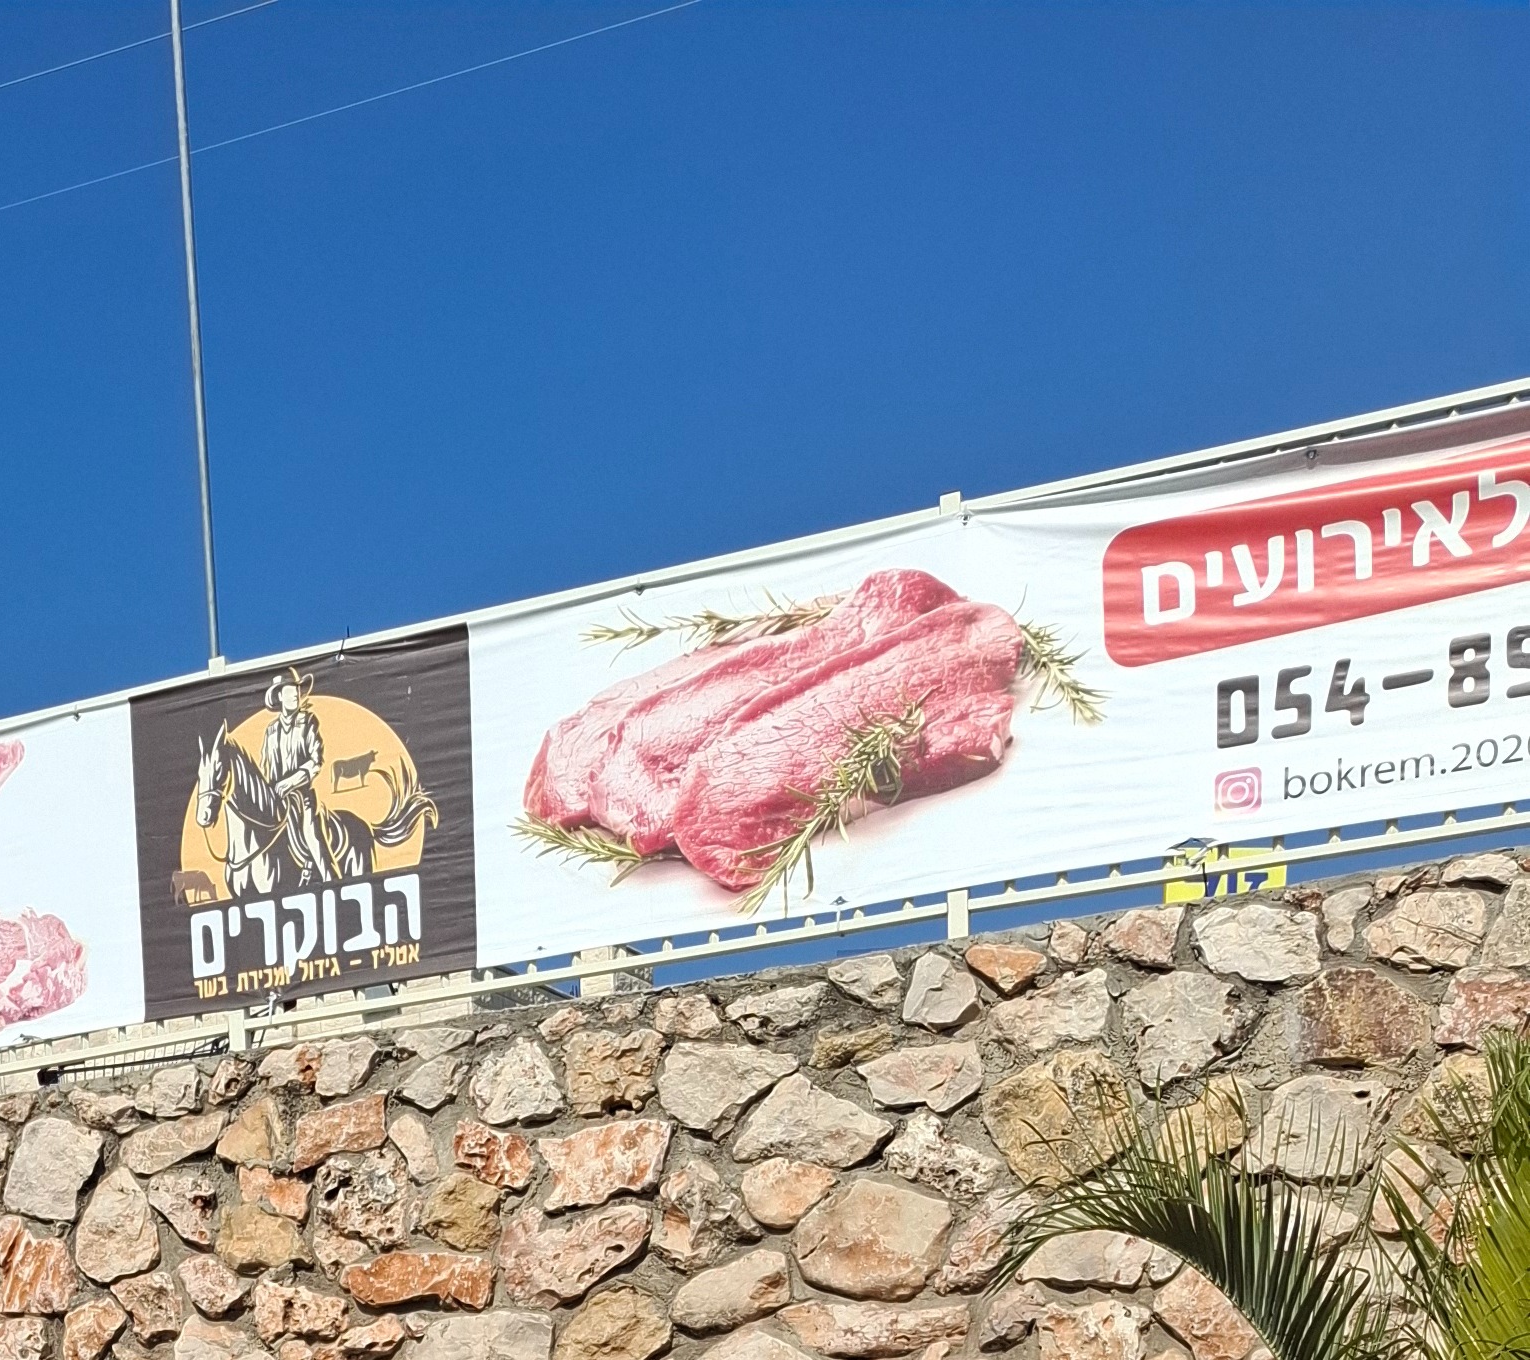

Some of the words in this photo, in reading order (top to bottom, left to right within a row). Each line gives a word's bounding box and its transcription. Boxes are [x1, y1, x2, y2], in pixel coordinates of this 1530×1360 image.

[1141, 470, 1530, 626] לאירועים
[1216, 625, 1530, 749] 054-89
[1284, 734, 1530, 800] bokrem.202
[191, 873, 421, 978] הבוקרים
[236, 965, 291, 993] ומכירת
[298, 957, 341, 982] גידול
[371, 943, 420, 970] אטליז
[193, 976, 229, 999] בשר
